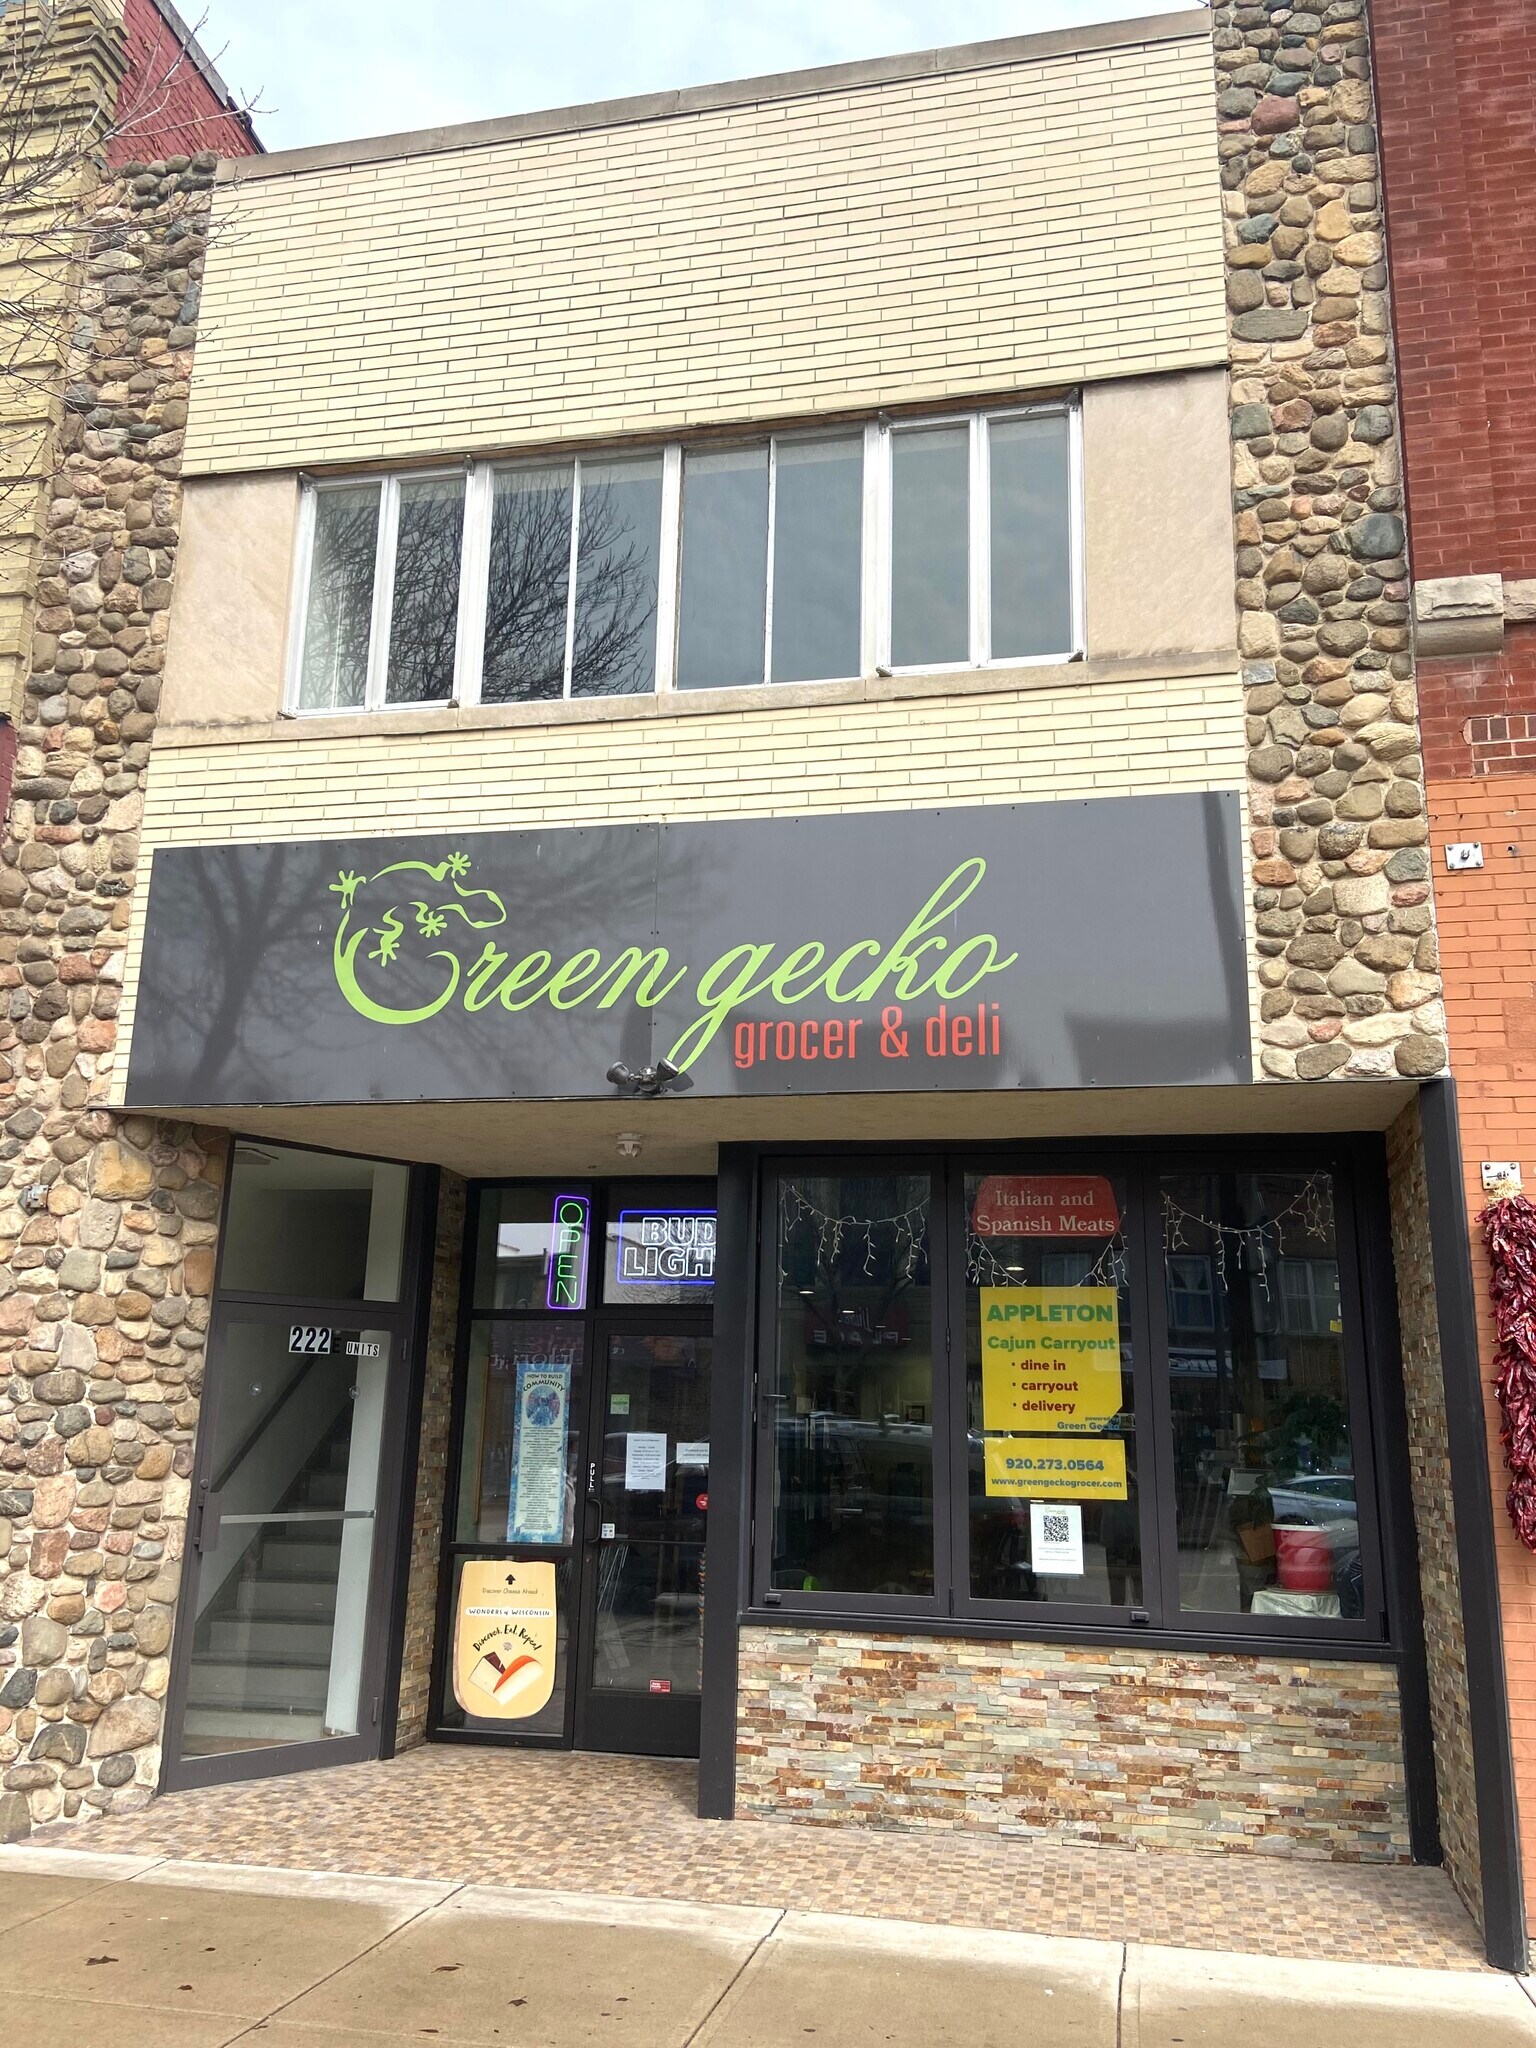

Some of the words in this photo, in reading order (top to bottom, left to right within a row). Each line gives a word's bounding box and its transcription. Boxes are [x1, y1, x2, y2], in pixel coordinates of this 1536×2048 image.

[329, 851, 688, 1025] Green
[667, 857, 1019, 1077] gecko
[735, 1018, 863, 1069] grocer
[879, 1004, 911, 1059] &
[925, 1002, 1000, 1058] deli
[995, 1190, 1055, 1206] Italian
[1060, 1190, 1095, 1206] and
[641, 1216, 718, 1247] BUD
[976, 1214, 1053, 1236] Spanish
[1058, 1215, 1116, 1231] Meats
[556, 1202, 583, 1304] OPEN
[623, 1246, 717, 1277] LIGH
[985, 1304, 1114, 1322] APPLETON
[291, 1326, 330, 1352] 222
[347, 1342, 379, 1356] UNITS
[987, 1336, 1037, 1352] Cajun
[1040, 1336, 1117, 1352] Carryout
[1020, 1359, 1050, 1371] dine
[1053, 1359, 1067, 1371] in
[523, 1379, 565, 1391] COMMUNITY
[1021, 1381, 1079, 1393] carryout
[1022, 1400, 1077, 1414] delivery
[1056, 1421, 1087, 1431] Green
[1005, 1458, 1105, 1471] 920.273.0564
[991, 1477, 1123, 1488] www.greengeckogrocer.com
